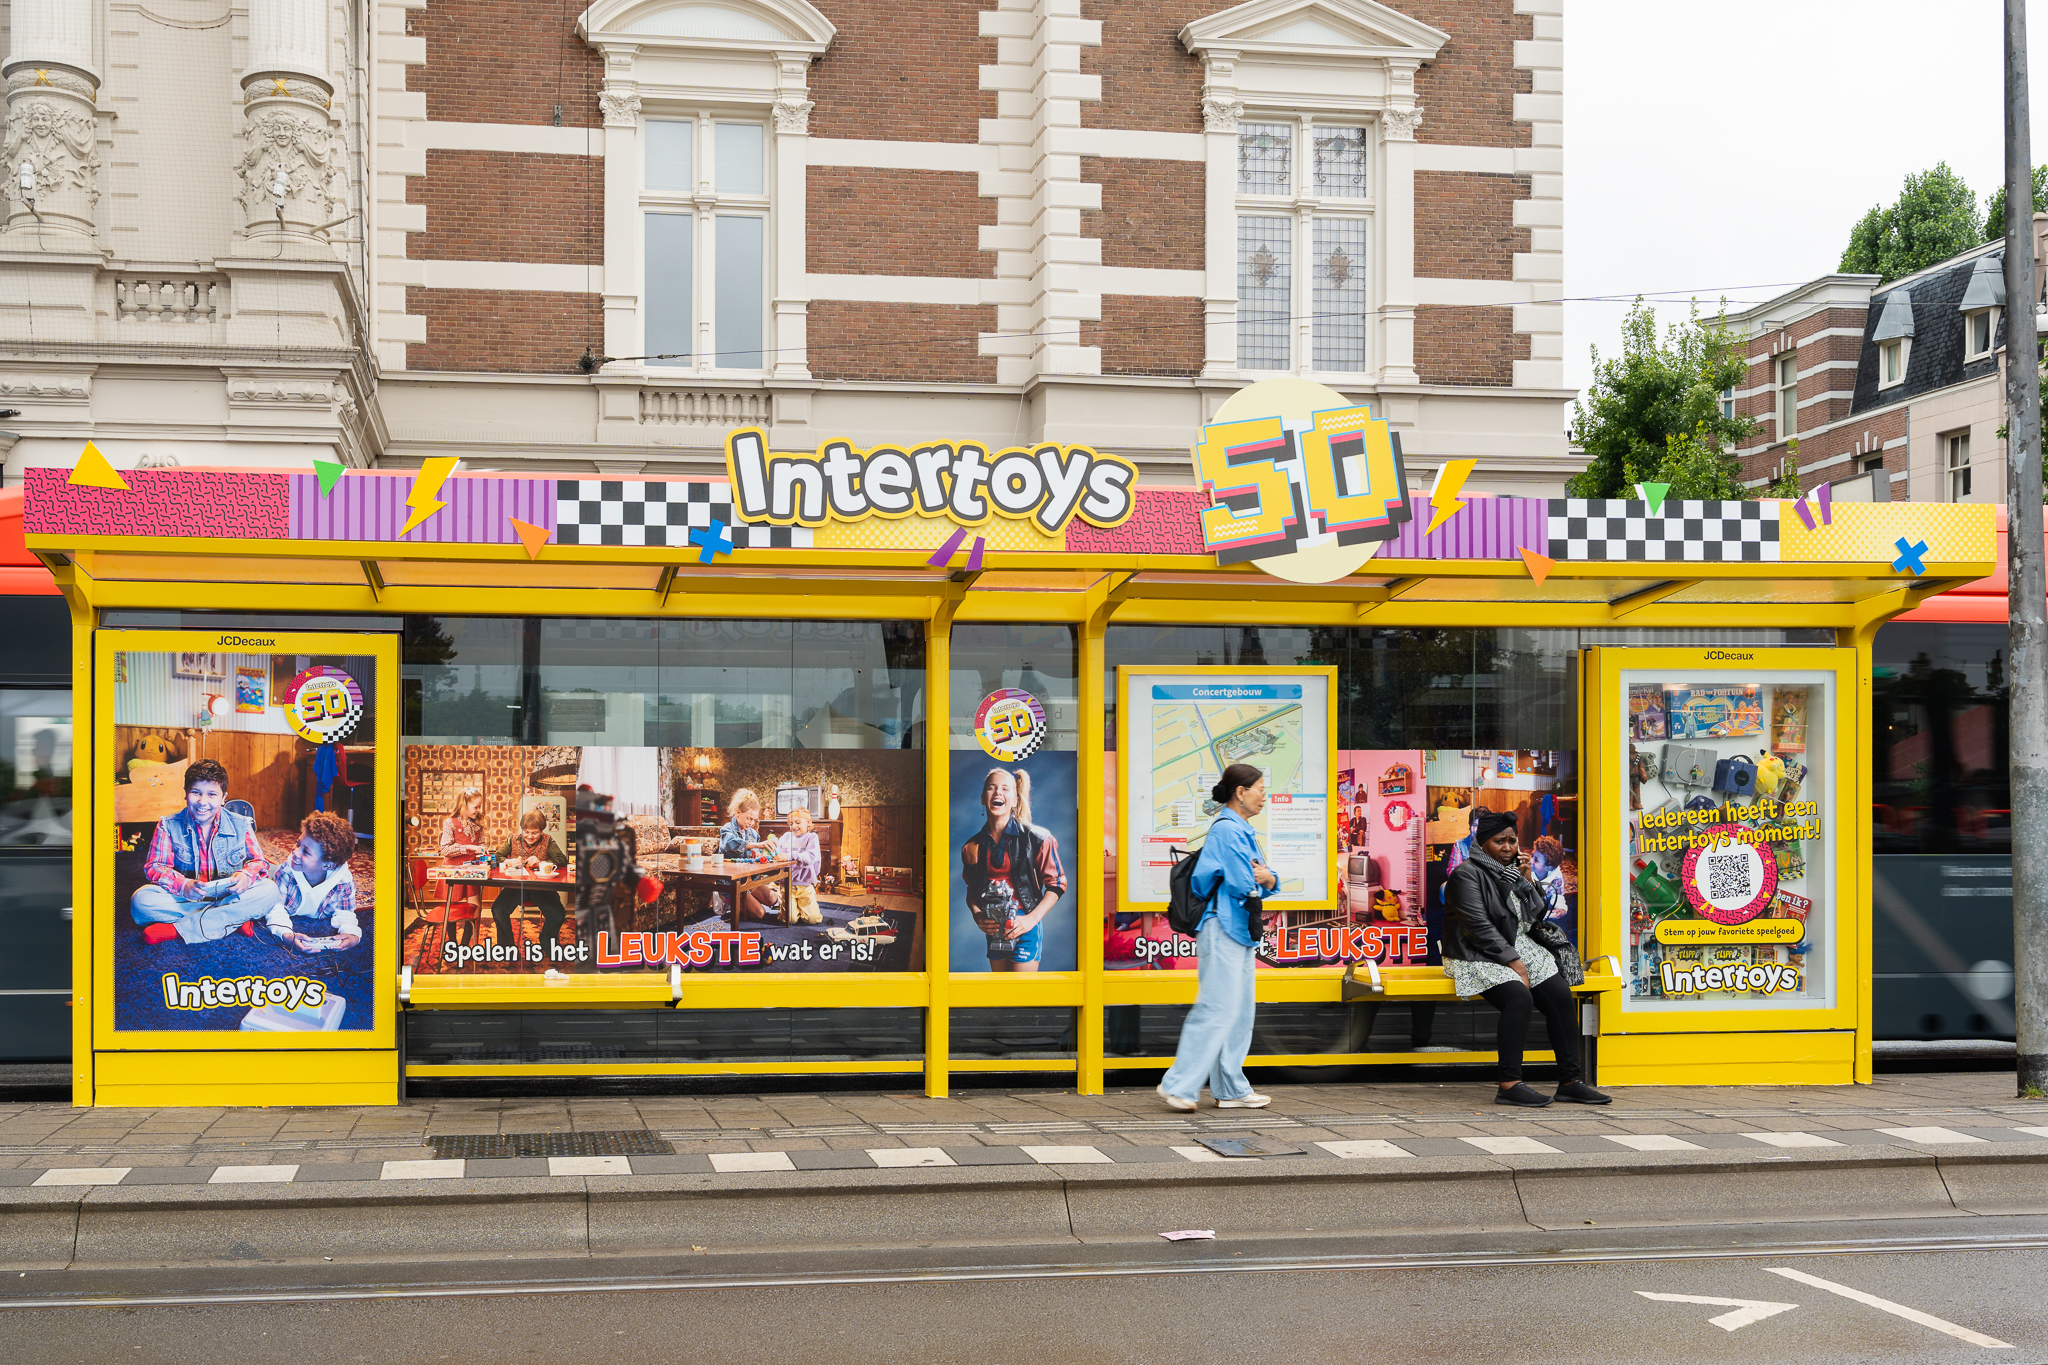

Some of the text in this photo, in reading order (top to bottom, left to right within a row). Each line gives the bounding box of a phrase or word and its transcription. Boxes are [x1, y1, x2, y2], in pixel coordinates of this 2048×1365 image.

[731, 430, 1133, 535] Intertoys
[1197, 404, 1411, 565] 50
[216, 636, 276, 647] JCDecaux
[1704, 651, 1754, 662] JCDecaux
[306, 681, 337, 691] Intertoys
[1193, 687, 1262, 698] Concertgebouw
[1690, 689, 1705, 697] RAD
[1713, 688, 1744, 696] FORTUIN
[301, 689, 350, 723] 50
[992, 701, 1021, 713] Intertoys
[989, 708, 1035, 744] 50
[1638, 799, 1817, 829] Iedereen heeft een
[1639, 818, 1821, 852] Intertoys moment!
[1776, 889, 1791, 903] ben
[1276, 925, 1428, 963] LEUKSTE
[1664, 928, 1684, 936] Stem
[1698, 928, 1715, 938] jouw
[1718, 927, 1754, 936] favoriete
[1756, 926, 1795, 938] speelgoed
[444, 931, 875, 969] Spelen is het LEUKSTE wat er is!
[164, 973, 326, 1011] Intertoys
[1662, 963, 1797, 995] Intertoys
